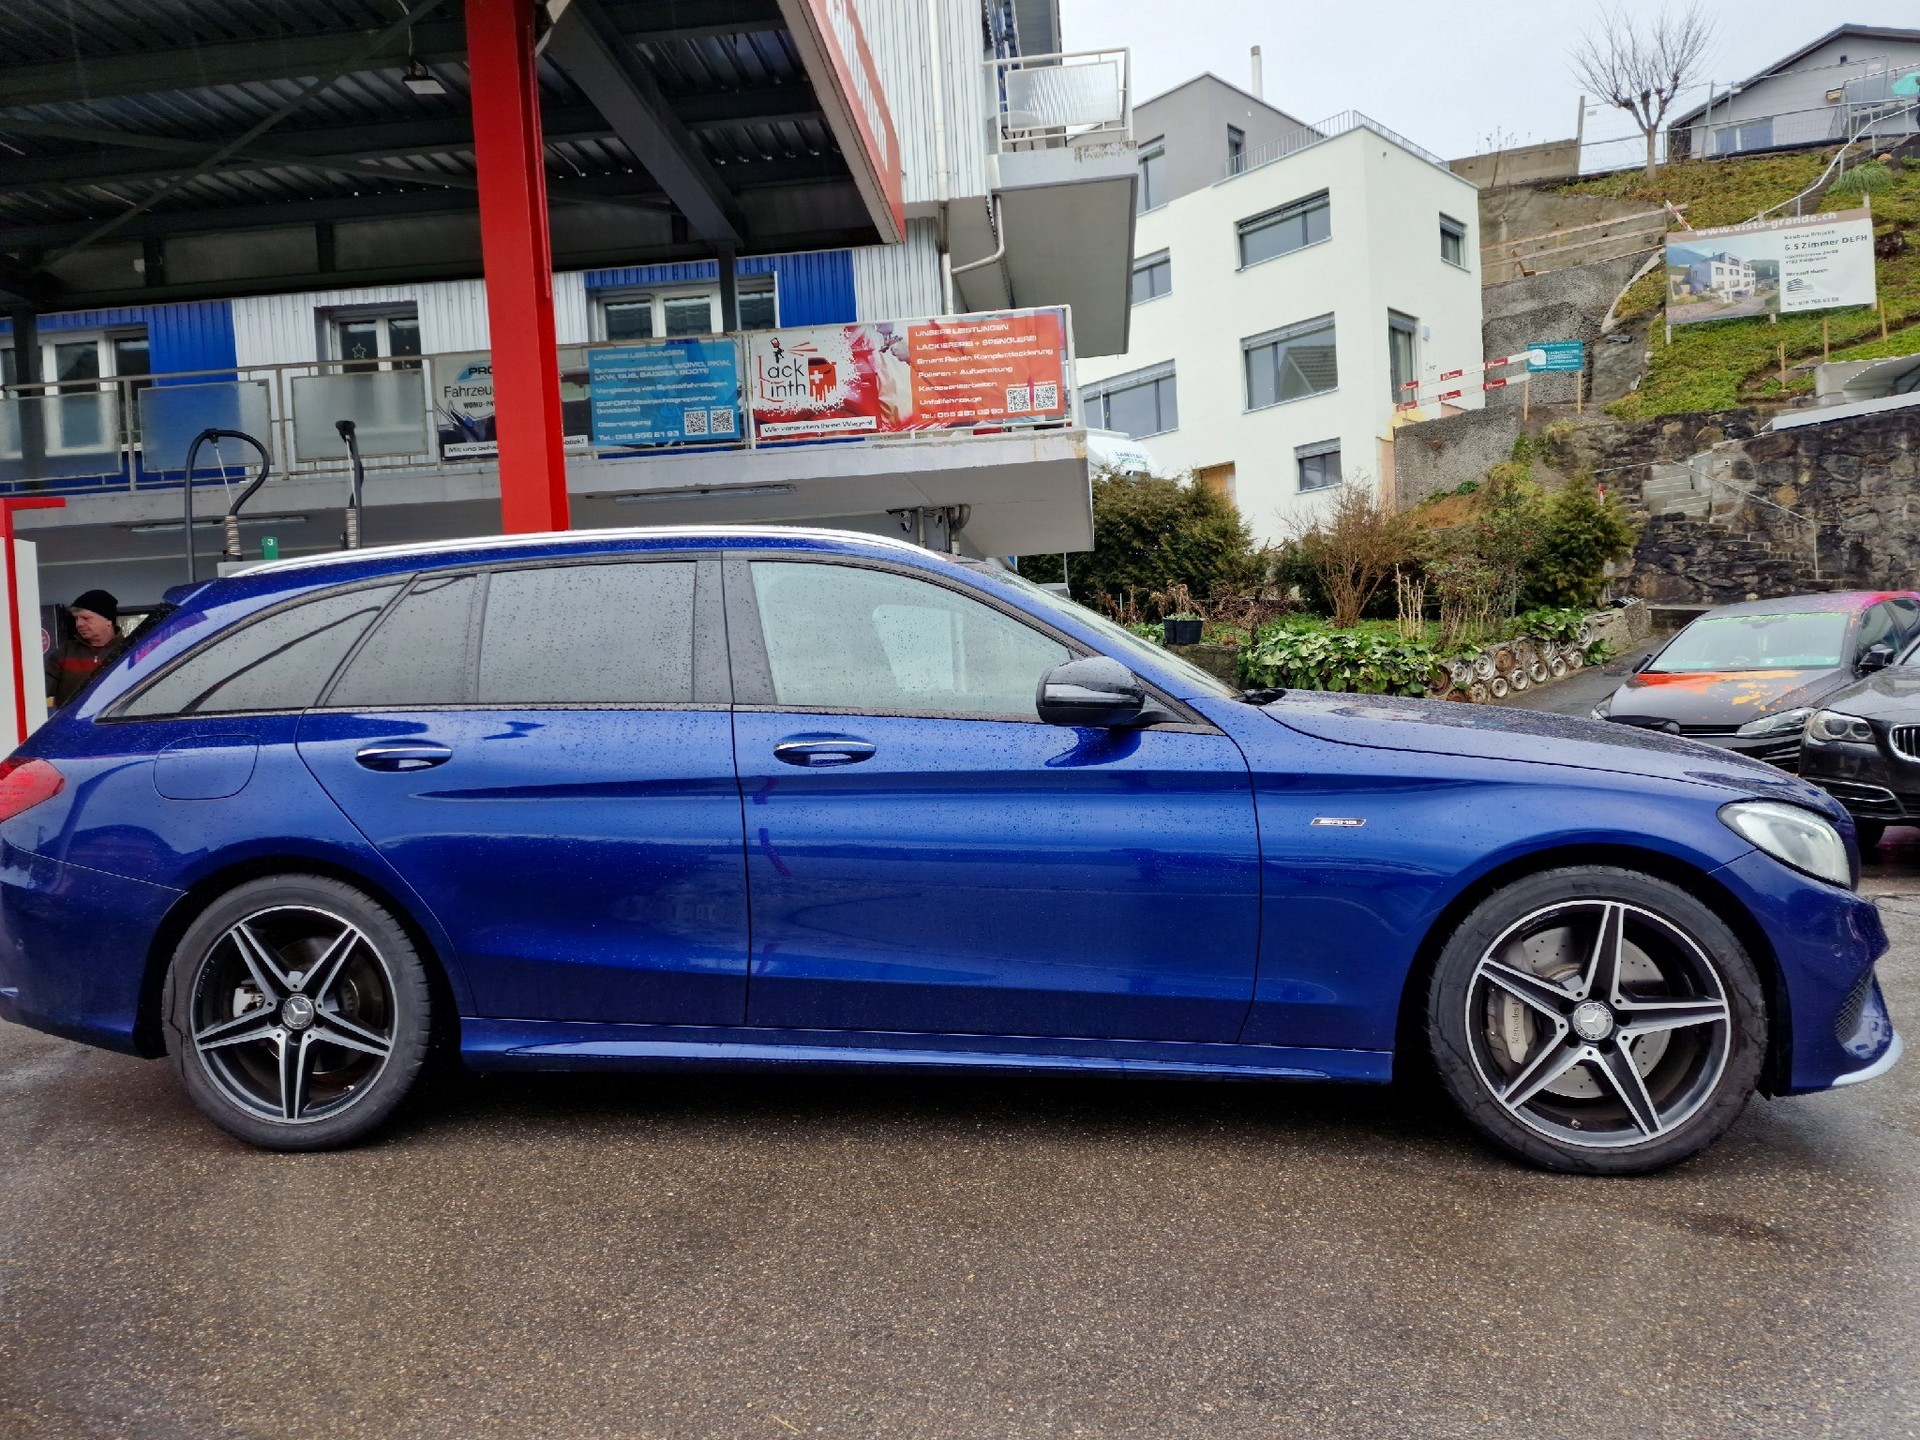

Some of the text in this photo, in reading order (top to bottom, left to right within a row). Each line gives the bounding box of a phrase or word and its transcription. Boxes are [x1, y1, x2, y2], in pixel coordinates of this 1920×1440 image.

[1695, 212, 1838, 237] www.vista-grande.ch
[1801, 239, 1839, 249] Zimmer
[915, 324, 1009, 337] UNSERE LEISTUNGEN
[916, 340, 974, 351] LACKIEREREI
[982, 335, 1037, 346] SPENGLEREI
[593, 349, 685, 361] UNSERE LEISTUNGEN
[916, 357, 944, 365] Smart
[679, 367, 710, 376] BOOTE
[757, 354, 805, 384] Lack
[959, 366, 1014, 375] Aufbereitung
[443, 385, 495, 399] Fahrzeu
[595, 386, 641, 395] Verglasung
[759, 379, 807, 403] Linth
[919, 396, 983, 406] Unfallfahrzeuge
[597, 419, 652, 428] Glasreinigung
[478, 444, 498, 452] beha
[562, 438, 585, 447] blick!
[266, 538, 274, 546] 3
